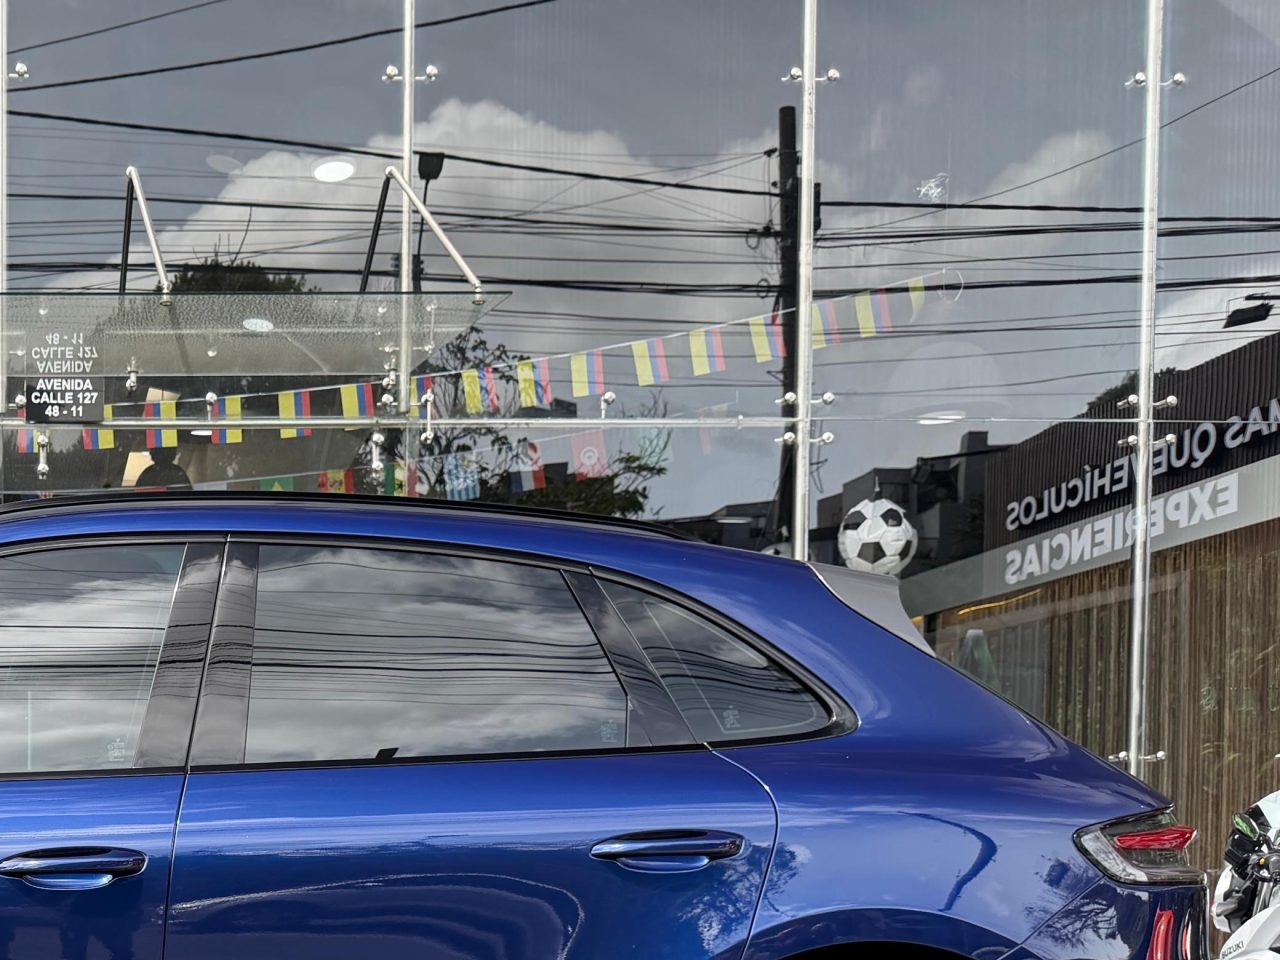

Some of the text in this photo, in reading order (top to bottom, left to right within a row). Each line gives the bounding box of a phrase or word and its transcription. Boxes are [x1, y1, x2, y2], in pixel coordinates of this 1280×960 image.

[36, 378, 93, 390] AVENIDA
[31, 391, 99, 404] CALLE 127
[45, 405, 60, 417] 48
[70, 405, 83, 417] 11
